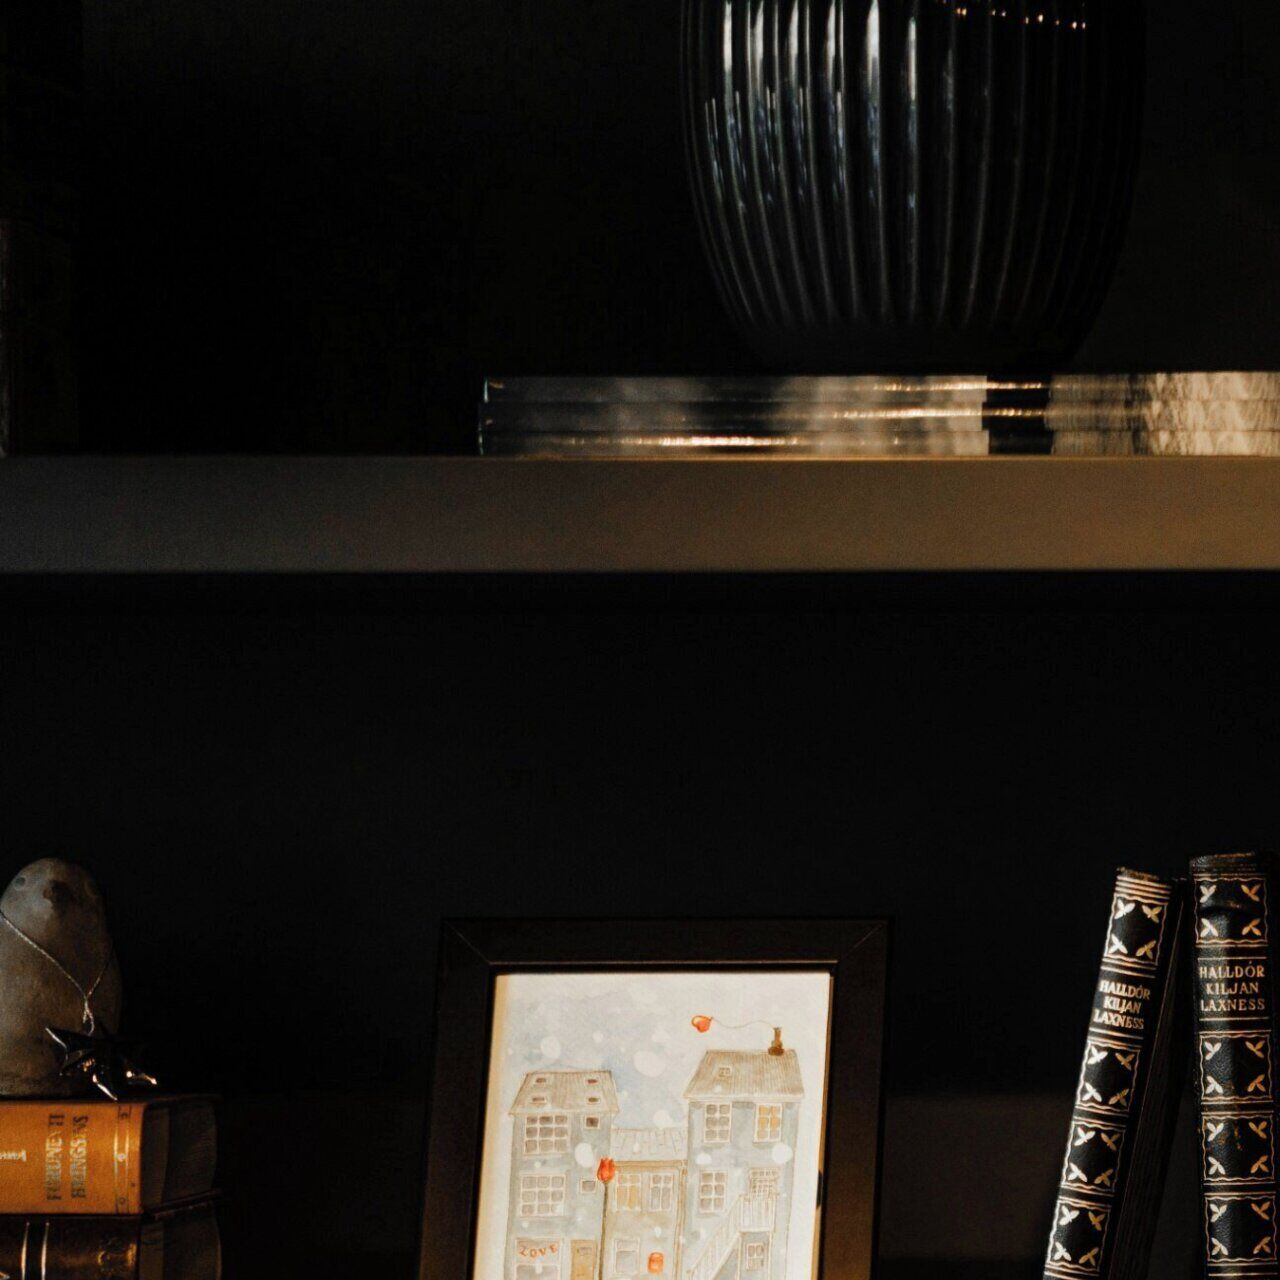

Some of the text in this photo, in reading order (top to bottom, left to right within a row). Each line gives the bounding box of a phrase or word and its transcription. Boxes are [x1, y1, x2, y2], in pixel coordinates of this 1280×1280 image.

[1199, 961, 1266, 979] HALLDÓR
[1099, 979, 1151, 1002] HALLDÓR
[1205, 982, 1259, 995] KILJAN
[1103, 996, 1143, 1017] KILJAN
[1200, 998, 1266, 1012] LAXNESS
[1093, 1010, 1145, 1030] LAXNESS
